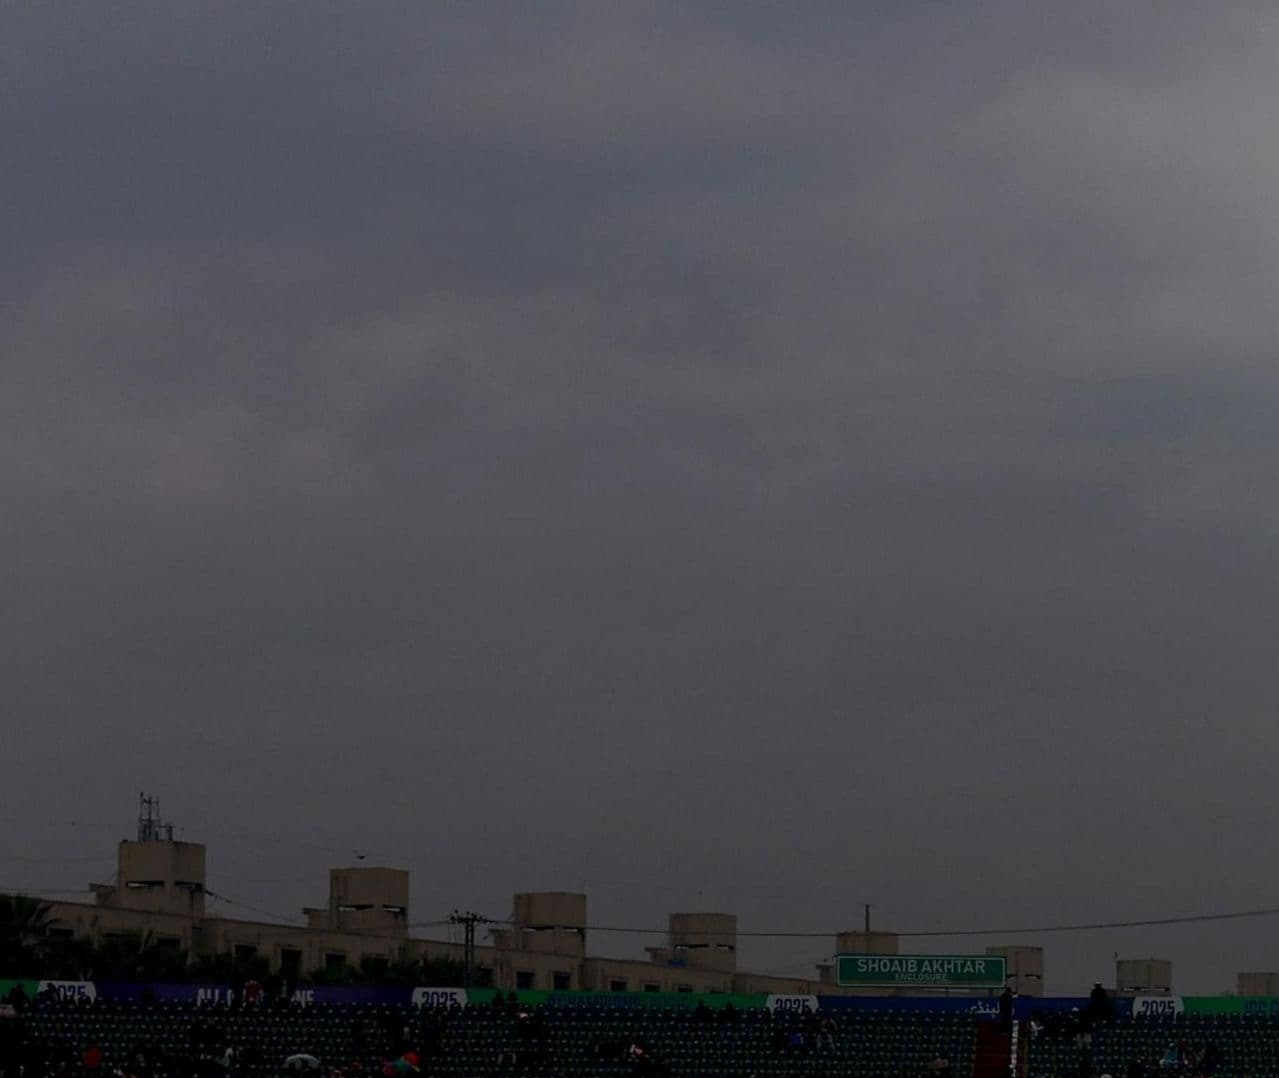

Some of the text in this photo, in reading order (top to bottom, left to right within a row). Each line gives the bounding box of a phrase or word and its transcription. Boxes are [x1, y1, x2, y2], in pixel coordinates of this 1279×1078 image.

[857, 959, 985, 973] SHOAIB AKHTAR
[895, 973, 946, 981] ENCLOSURE
[422, 991, 457, 1005] 2025
[1142, 1000, 1175, 1015] 2025
